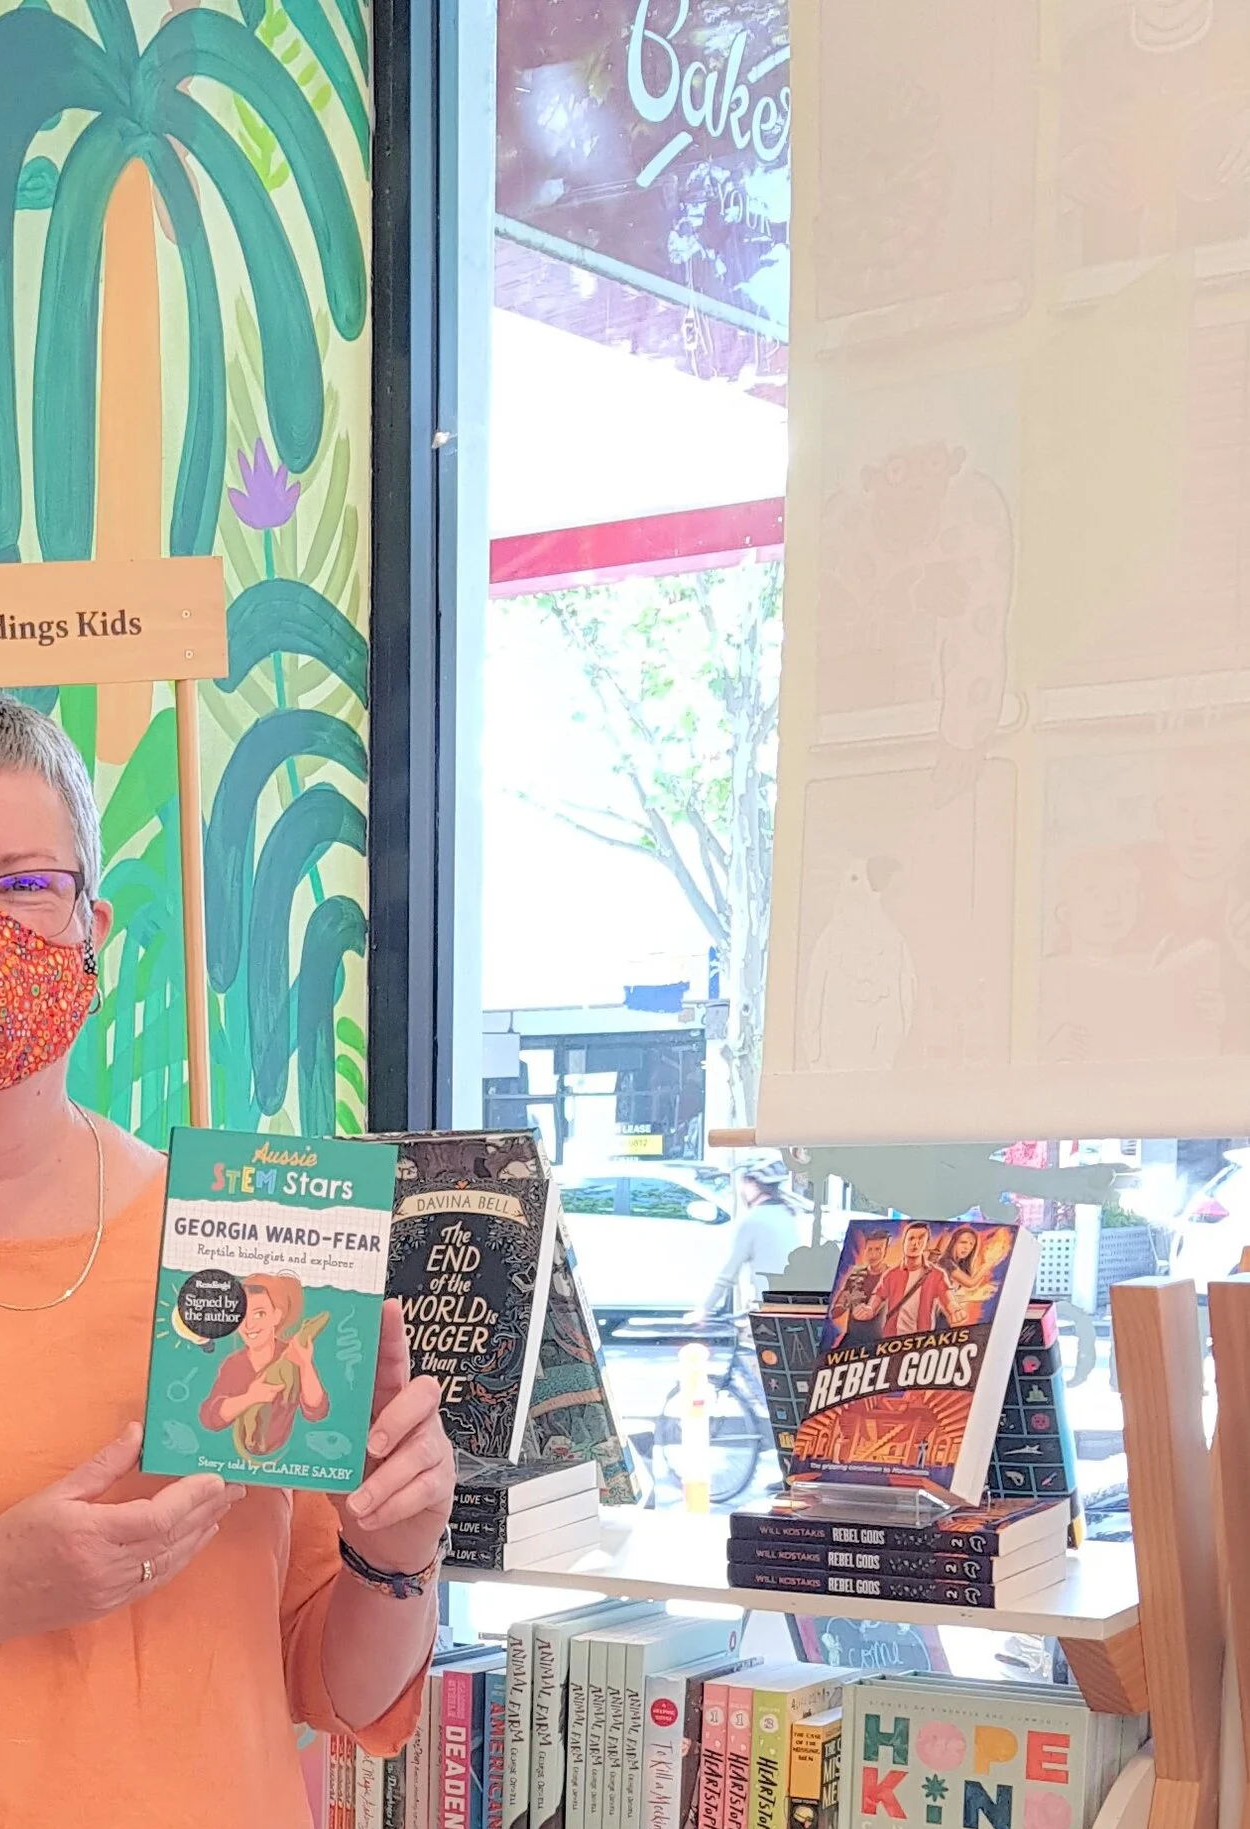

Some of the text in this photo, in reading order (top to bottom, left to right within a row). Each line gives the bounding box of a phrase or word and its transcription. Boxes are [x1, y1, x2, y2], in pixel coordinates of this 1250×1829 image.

[76, 611, 142, 638] Kids
[252, 1142, 318, 1168] Aussie
[211, 1162, 353, 1200] STEM Stars
[416, 1196, 509, 1214] DAVINA BELL
[174, 1217, 382, 1252] GEORGIA WARD-FEAR
[440, 1221, 472, 1246] The
[197, 1243, 355, 1270] Reptile biologist and explorer
[426, 1244, 481, 1273] END
[429, 1273, 472, 1295] of the
[184, 1310, 242, 1323] the author
[185, 1294, 239, 1312] Signed by
[398, 1295, 485, 1324] WORLD
[826, 1329, 971, 1366] WILL KOSTAKIS
[422, 1354, 457, 1372] than
[808, 1343, 979, 1415] REBEL GODS
[262, 1461, 309, 1477] CLAIRE
[311, 1466, 353, 1481] SAXBY
[535, 1636, 555, 1746] ANIMAL FARM
[863, 1714, 1072, 1785] HOPE
[651, 1758, 674, 1781] Kill
